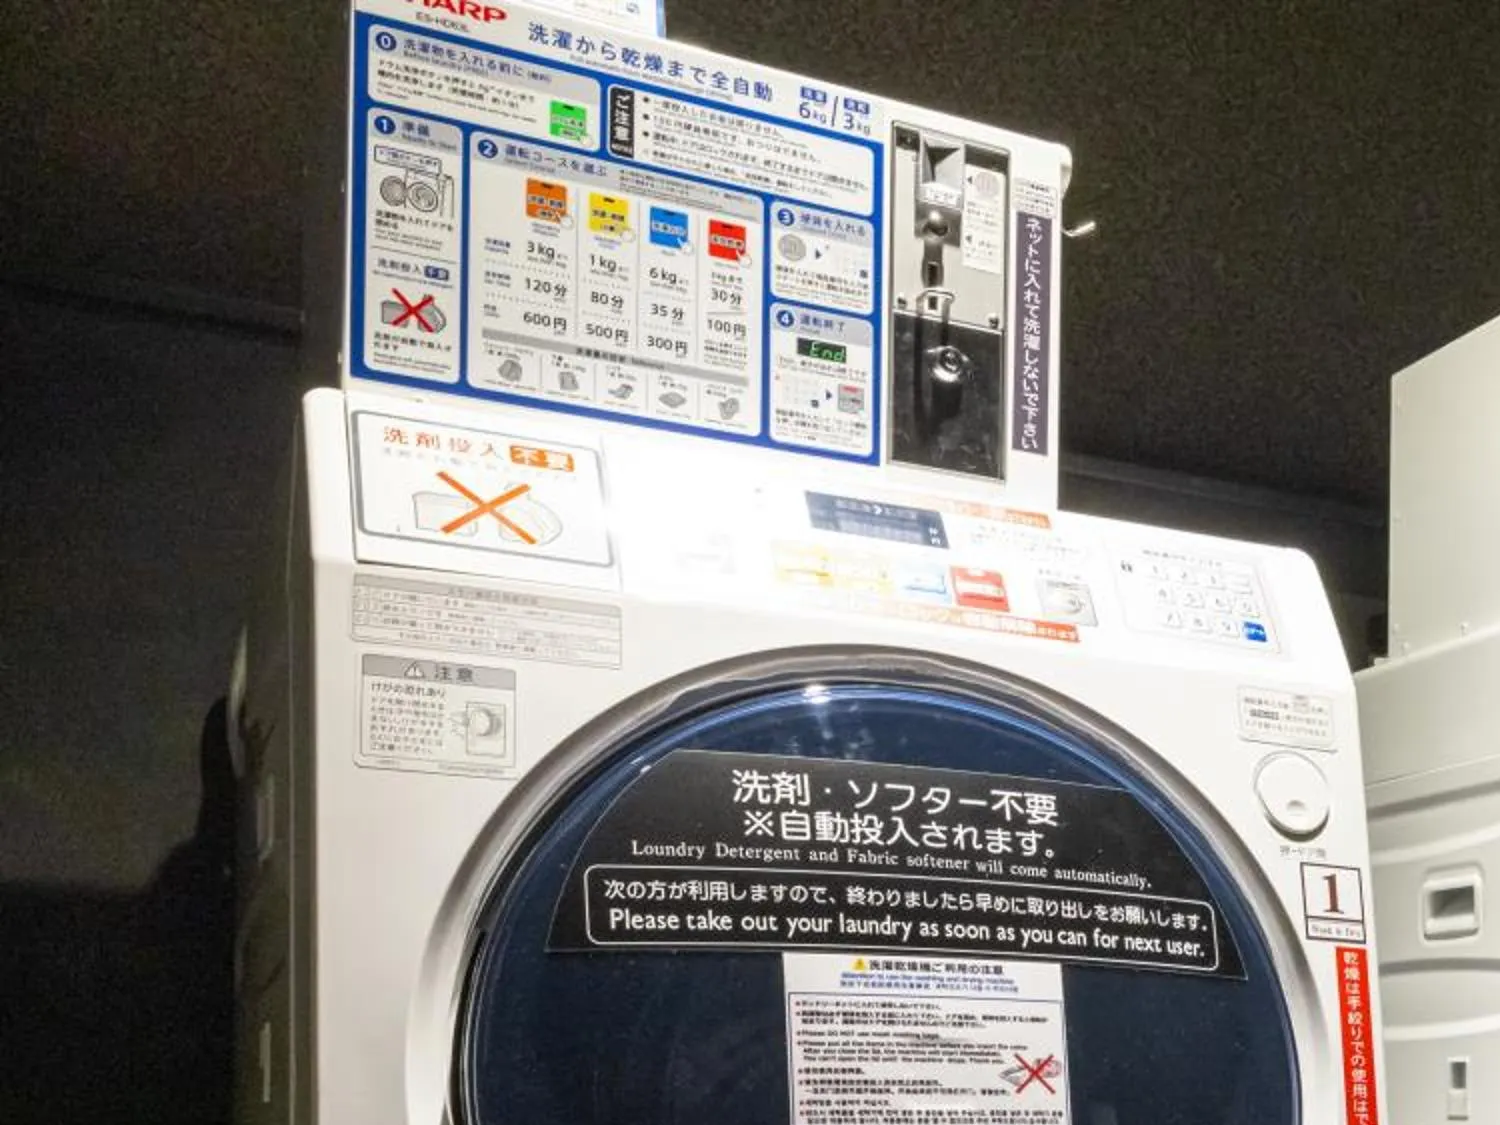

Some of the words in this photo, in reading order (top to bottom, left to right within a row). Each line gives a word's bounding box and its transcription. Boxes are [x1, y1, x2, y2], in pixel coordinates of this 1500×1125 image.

[404, 0, 507, 22] ARP
[528, 21, 773, 103] 洗濯から乾燥まで全自動
[435, 661, 473, 682] 注意
[732, 769, 1058, 827] 洗剤・ソフター不要
[744, 810, 1055, 858] ※自動投入されます。
[632, 840, 705, 860] Loundry
[715, 843, 800, 862] Detergent
[809, 848, 838, 862] and
[847, 850, 899, 866] Fabric
[907, 853, 969, 871] softener
[976, 858, 1003, 874] will
[1010, 864, 1048, 878] come
[1054, 867, 1152, 889] automatically.
[1322, 873, 1344, 914] 1
[609, 909, 680, 931] Please
[687, 911, 733, 931] take
[741, 914, 779, 931] out
[786, 917, 833, 938] your
[839, 913, 912, 942] laundry
[919, 921, 939, 937] as
[945, 923, 990, 940] soon
[997, 926, 1016, 941] as
[1021, 928, 1052, 948] you
[1057, 932, 1087, 946] can
[1094, 929, 1120, 949] for
[1124, 937, 1163, 953] next
[1165, 939, 1205, 957] user.
